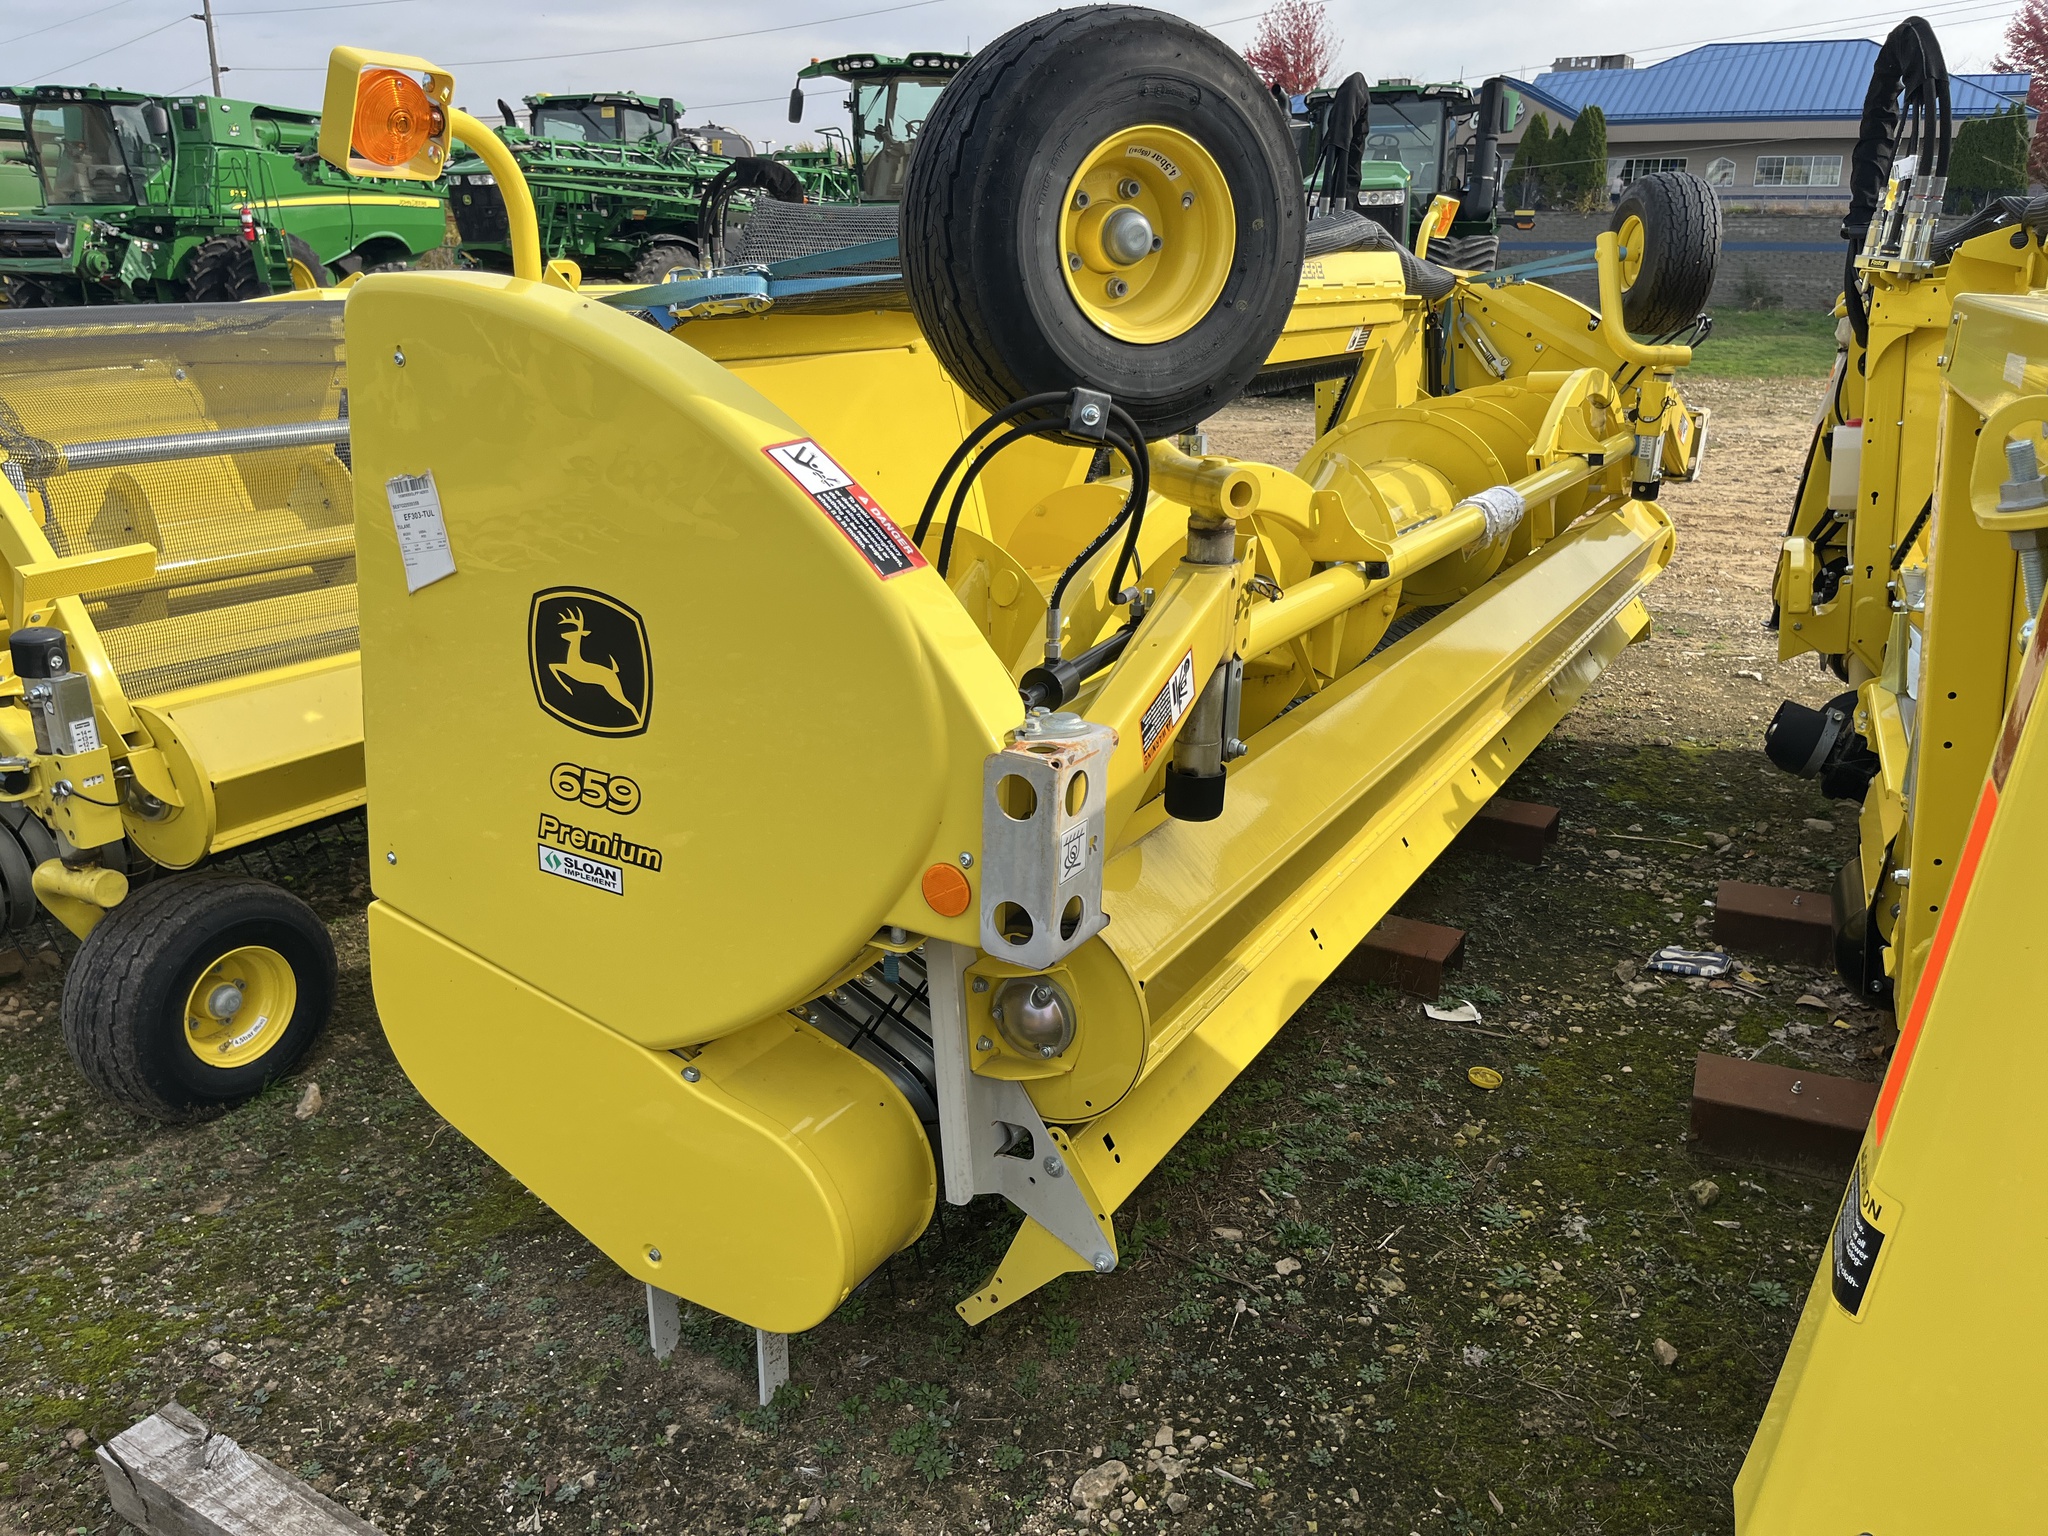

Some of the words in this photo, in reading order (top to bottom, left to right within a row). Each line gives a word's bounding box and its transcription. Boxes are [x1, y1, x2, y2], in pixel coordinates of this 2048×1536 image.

[1151, 153, 1177, 176] 4,5bar
[403, 509, 436, 522] EF303-TUL
[816, 495, 832, 510] when
[846, 528, 867, 549] motion.
[822, 493, 844, 515] clothing
[856, 531, 870, 544] near
[867, 545, 885, 562] auger
[836, 500, 846, 509] not
[845, 510, 860, 525] allow
[858, 525, 883, 551] person(s)
[841, 497, 857, 513] death
[856, 513, 869, 526] from
[868, 527, 903, 566] entanglement,
[854, 503, 870, 519] avoid
[868, 519, 888, 539] serious
[886, 540, 902, 557] injury
[870, 507, 914, 554] DANGER
[549, 762, 642, 816] 659
[537, 812, 663, 873] Premium
[563, 857, 617, 882] SLOAN
[564, 868, 617, 889] IMPLEMENT
